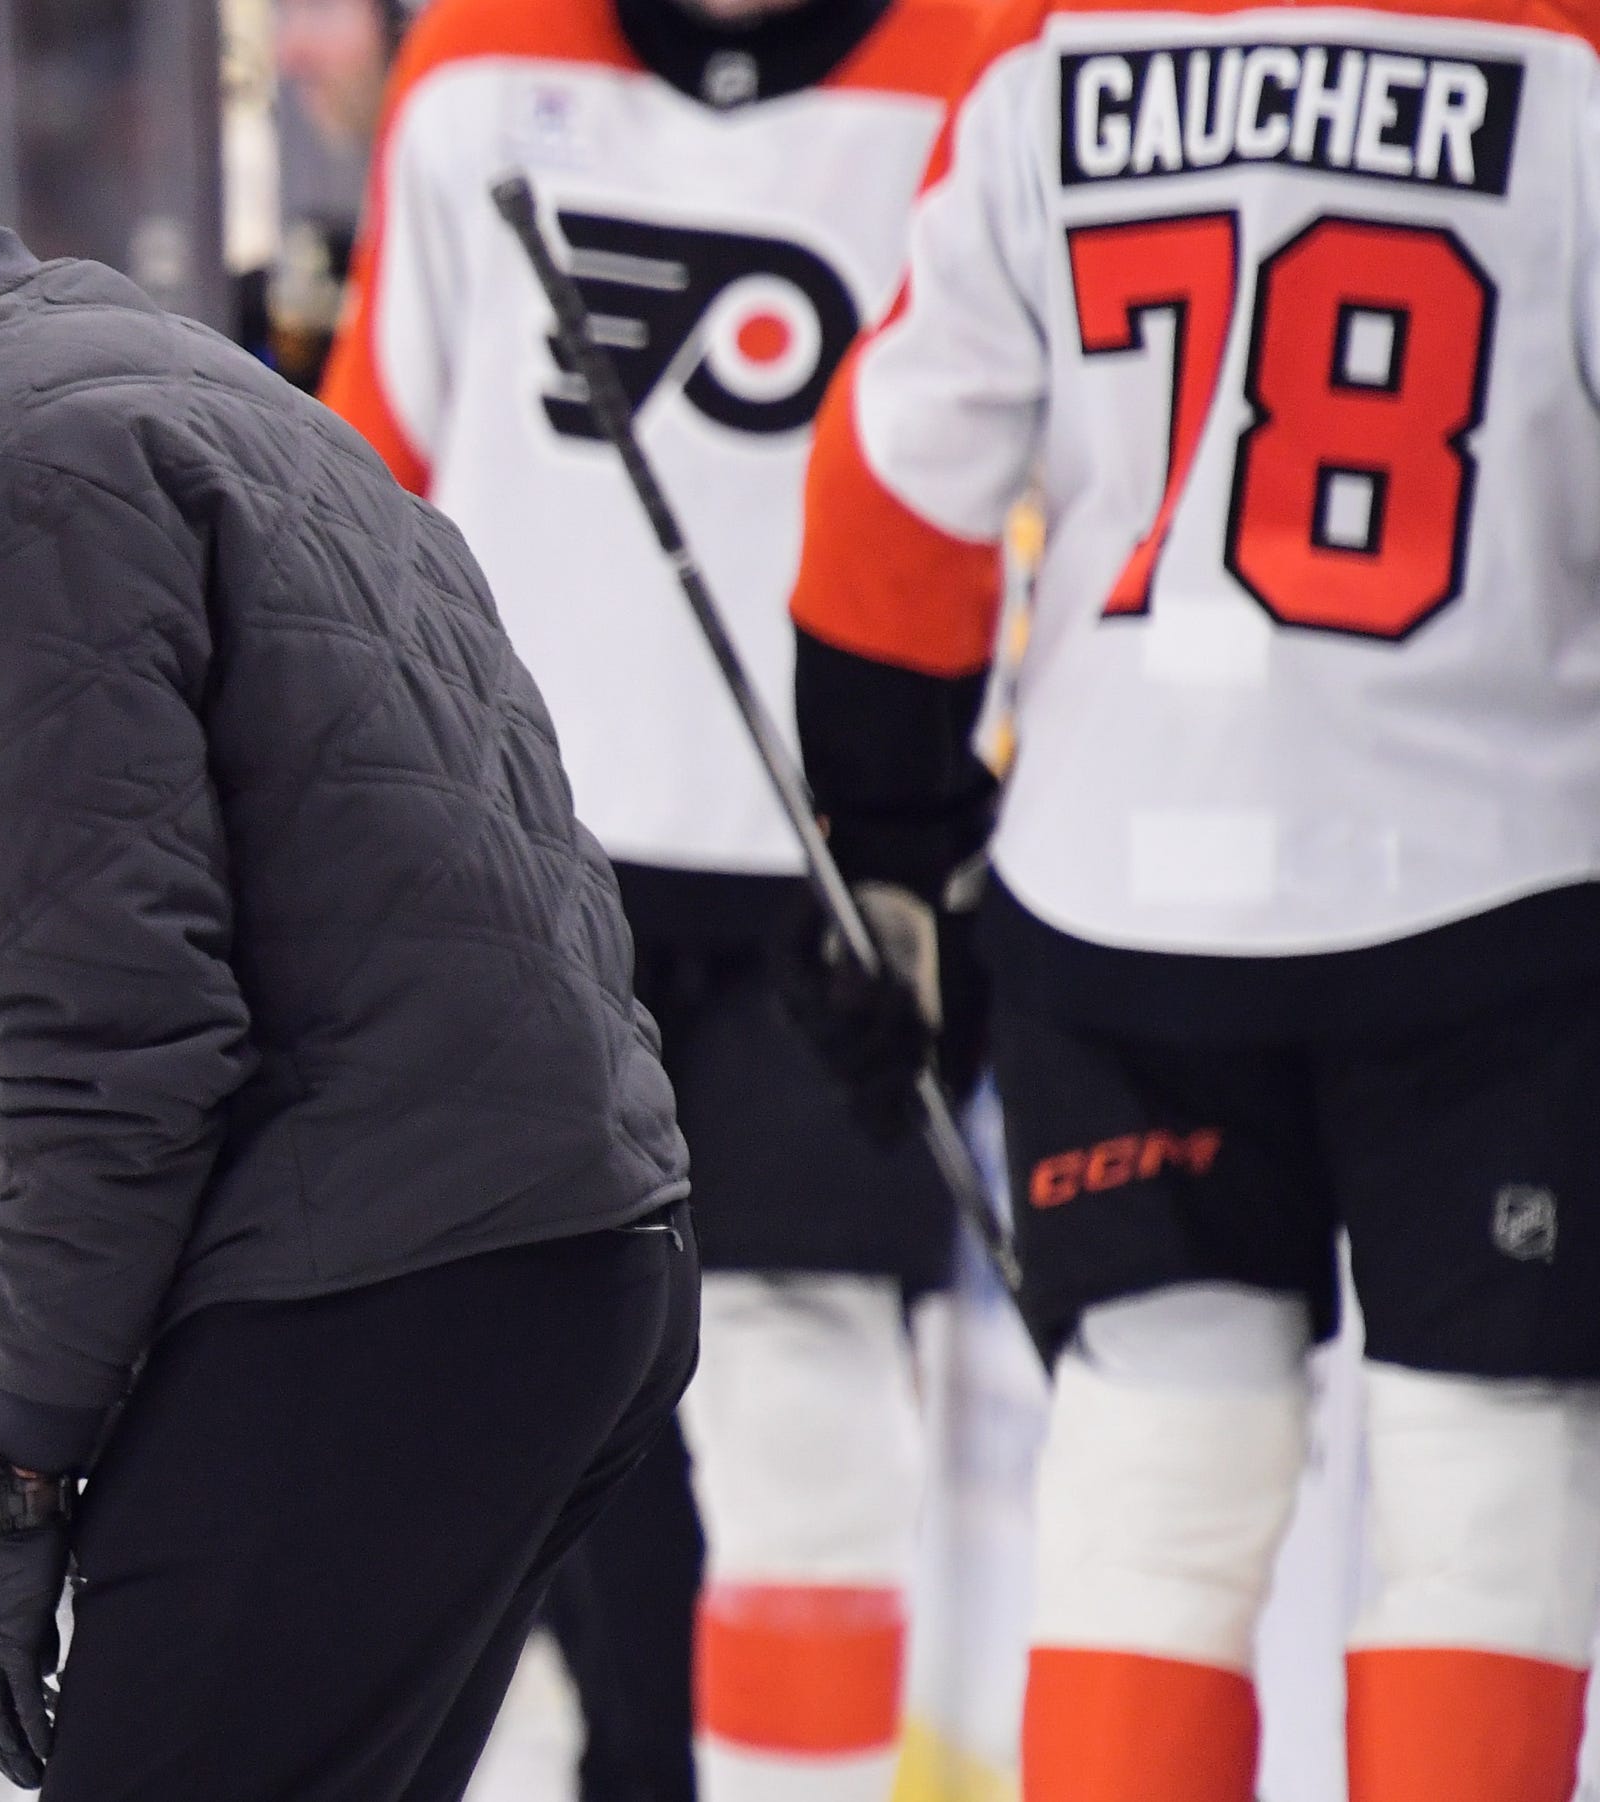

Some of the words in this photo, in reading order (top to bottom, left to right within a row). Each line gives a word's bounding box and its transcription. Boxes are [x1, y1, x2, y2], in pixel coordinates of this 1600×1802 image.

[1076, 45, 1489, 186] GAUCHER
[1066, 208, 1499, 642] 78
[1028, 1130, 1224, 1209] CCM
